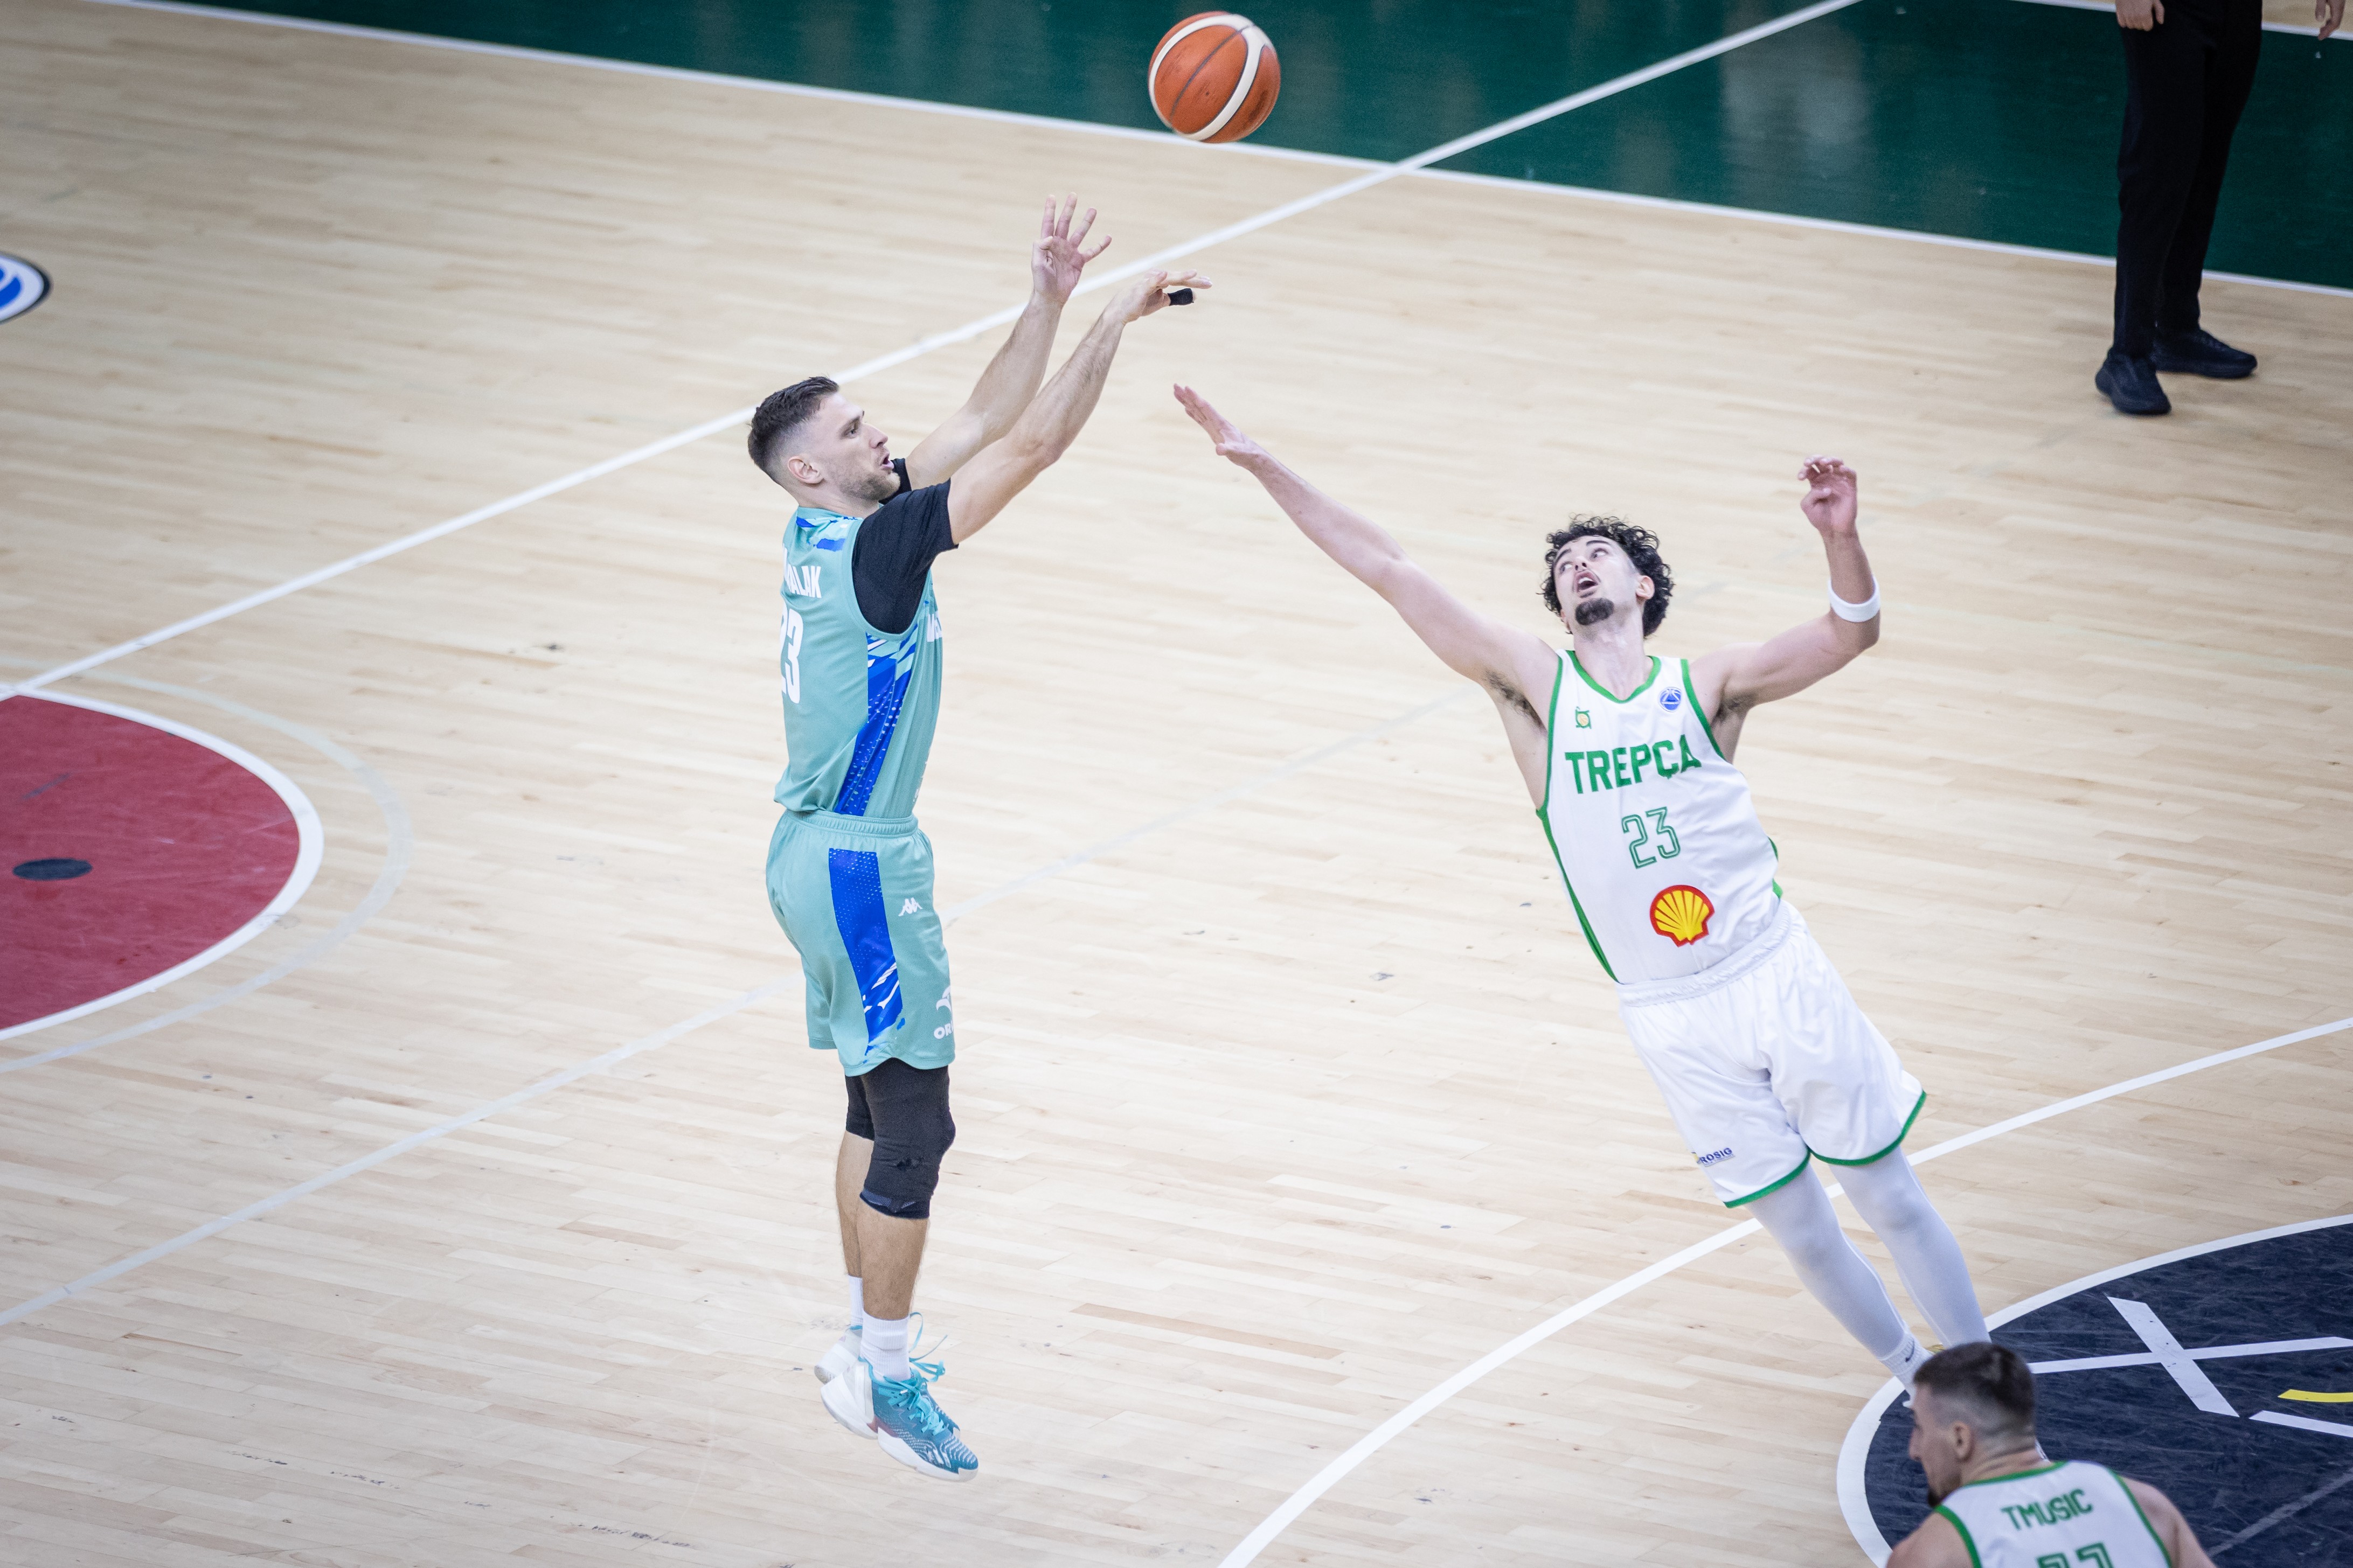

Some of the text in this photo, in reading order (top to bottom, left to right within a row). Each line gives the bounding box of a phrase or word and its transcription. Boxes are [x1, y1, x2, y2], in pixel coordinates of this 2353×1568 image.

[1621, 806, 1681, 869] 23
[1698, 1147, 1732, 1164] ROSIG
[2000, 1488, 2093, 1531] TMUSIC
